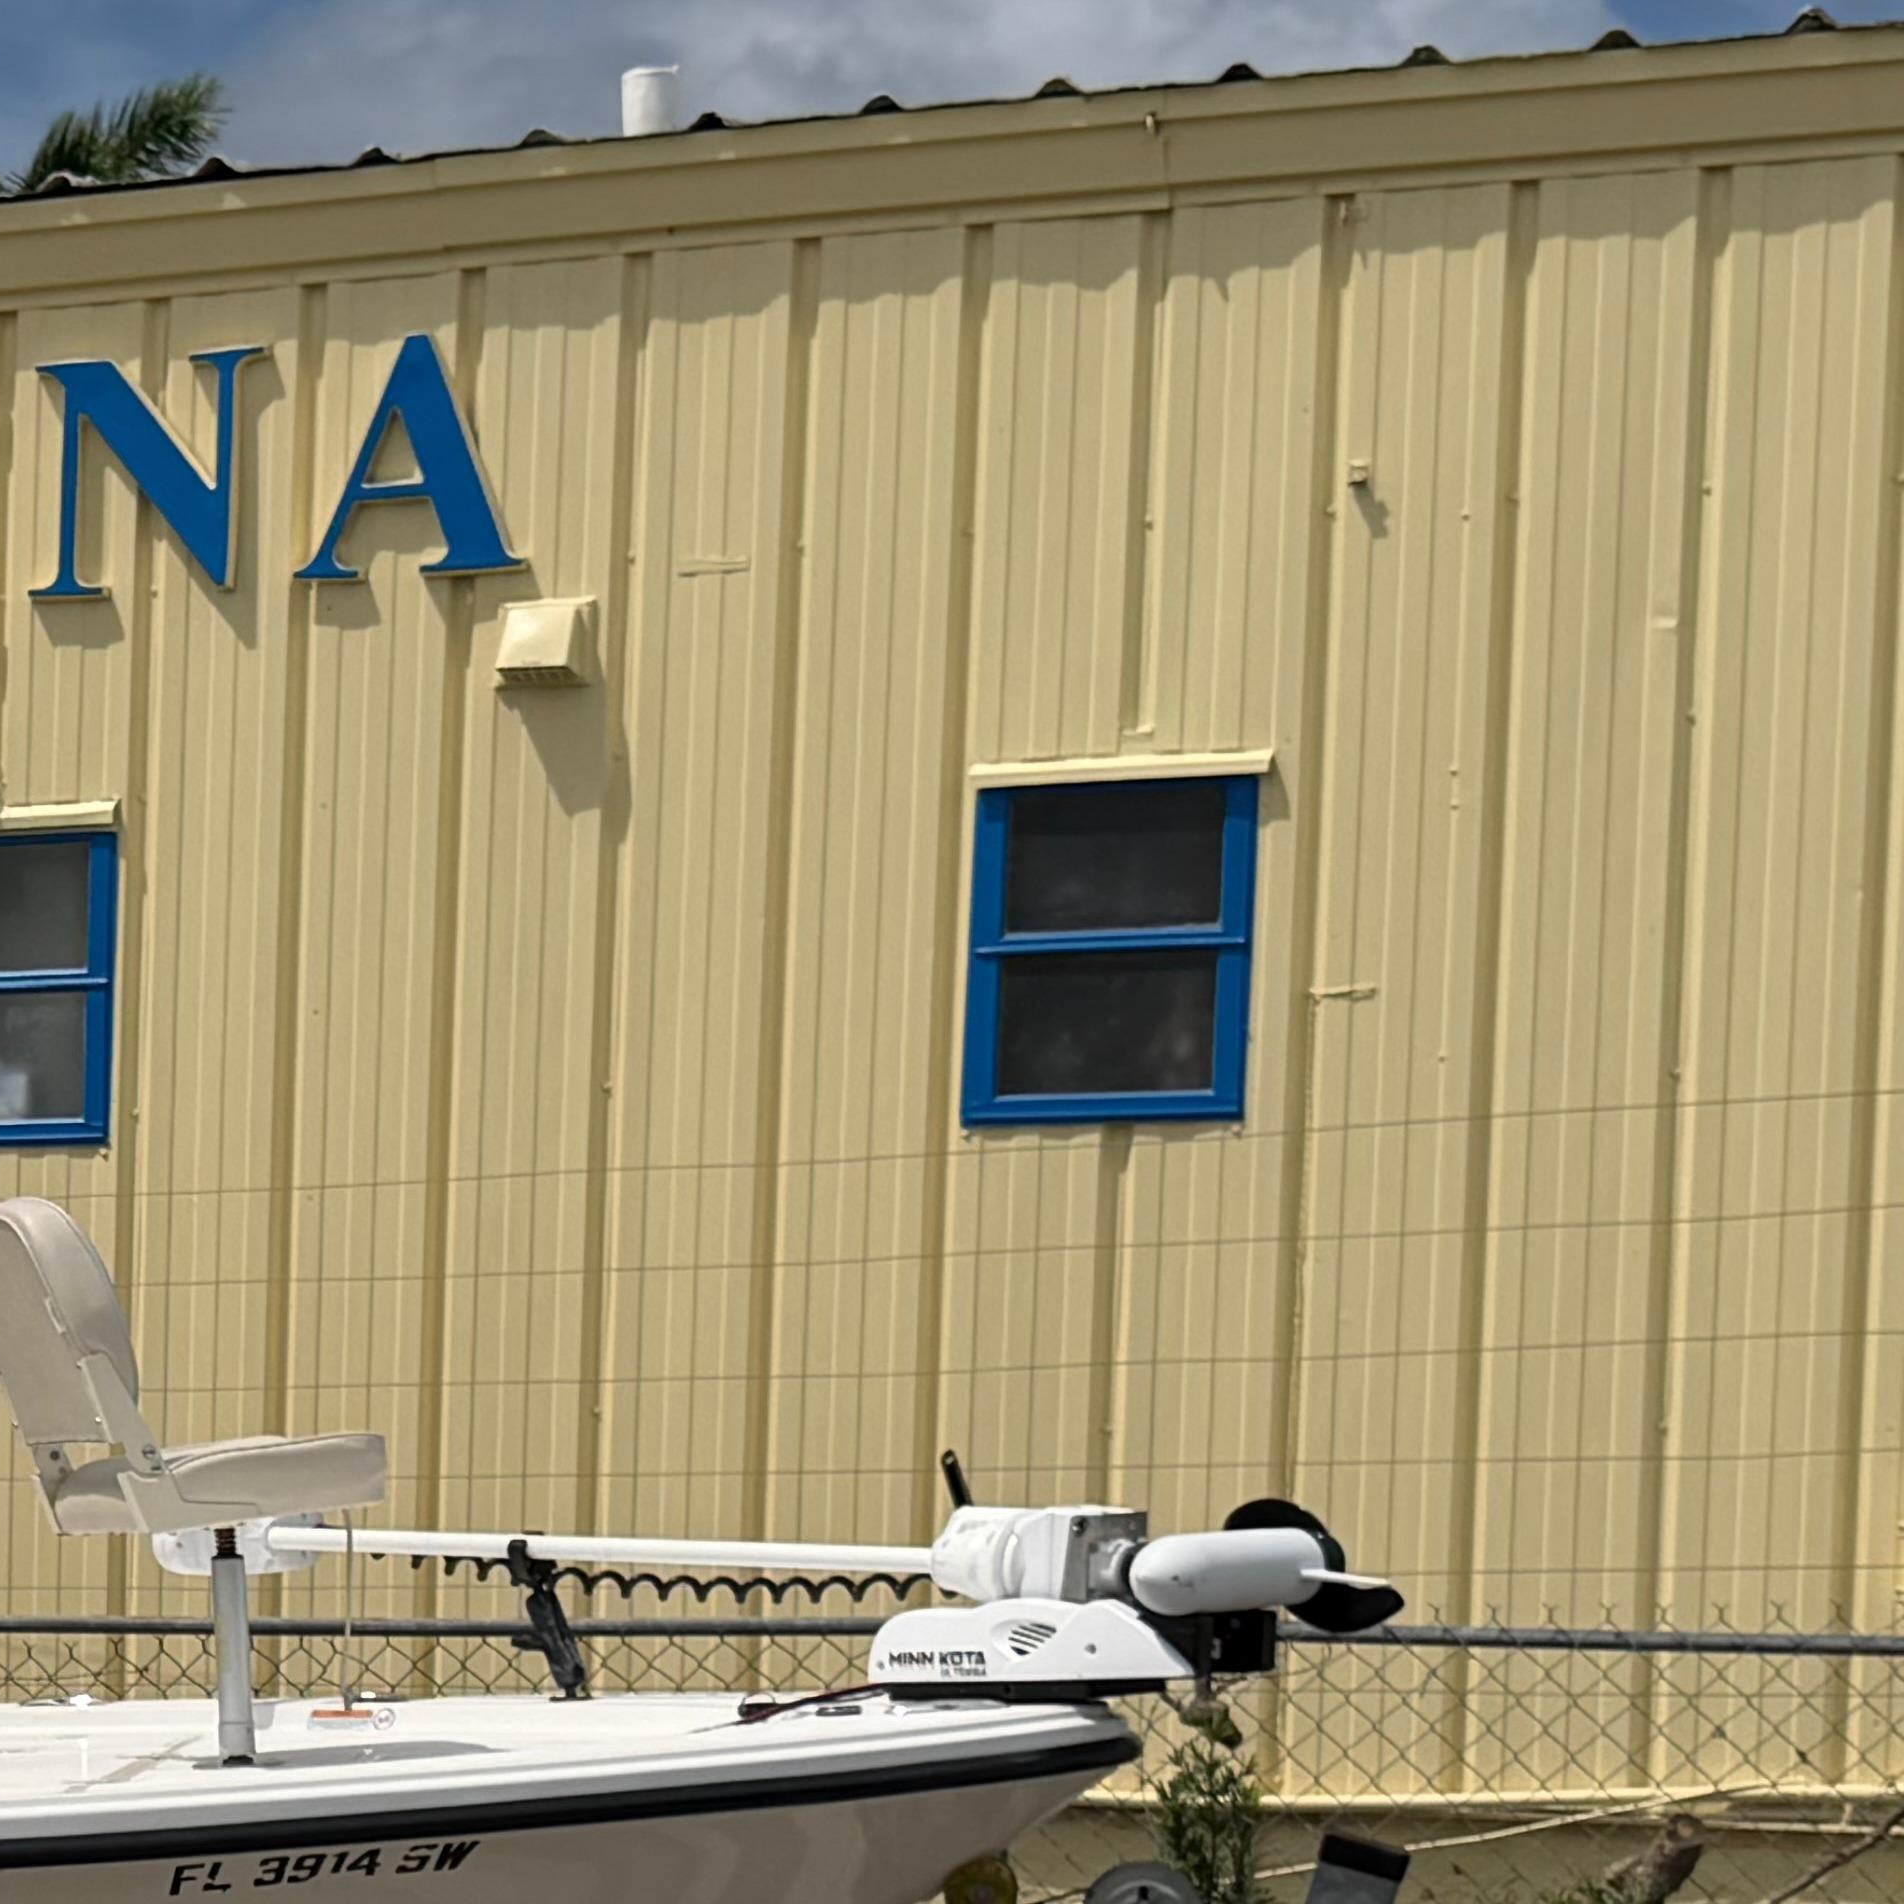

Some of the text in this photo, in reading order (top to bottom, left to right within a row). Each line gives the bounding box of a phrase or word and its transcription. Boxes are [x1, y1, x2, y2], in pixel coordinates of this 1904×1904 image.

[889, 1651, 986, 1666] MINN KOTA
[169, 1840, 481, 1896] FL 3914 SW
